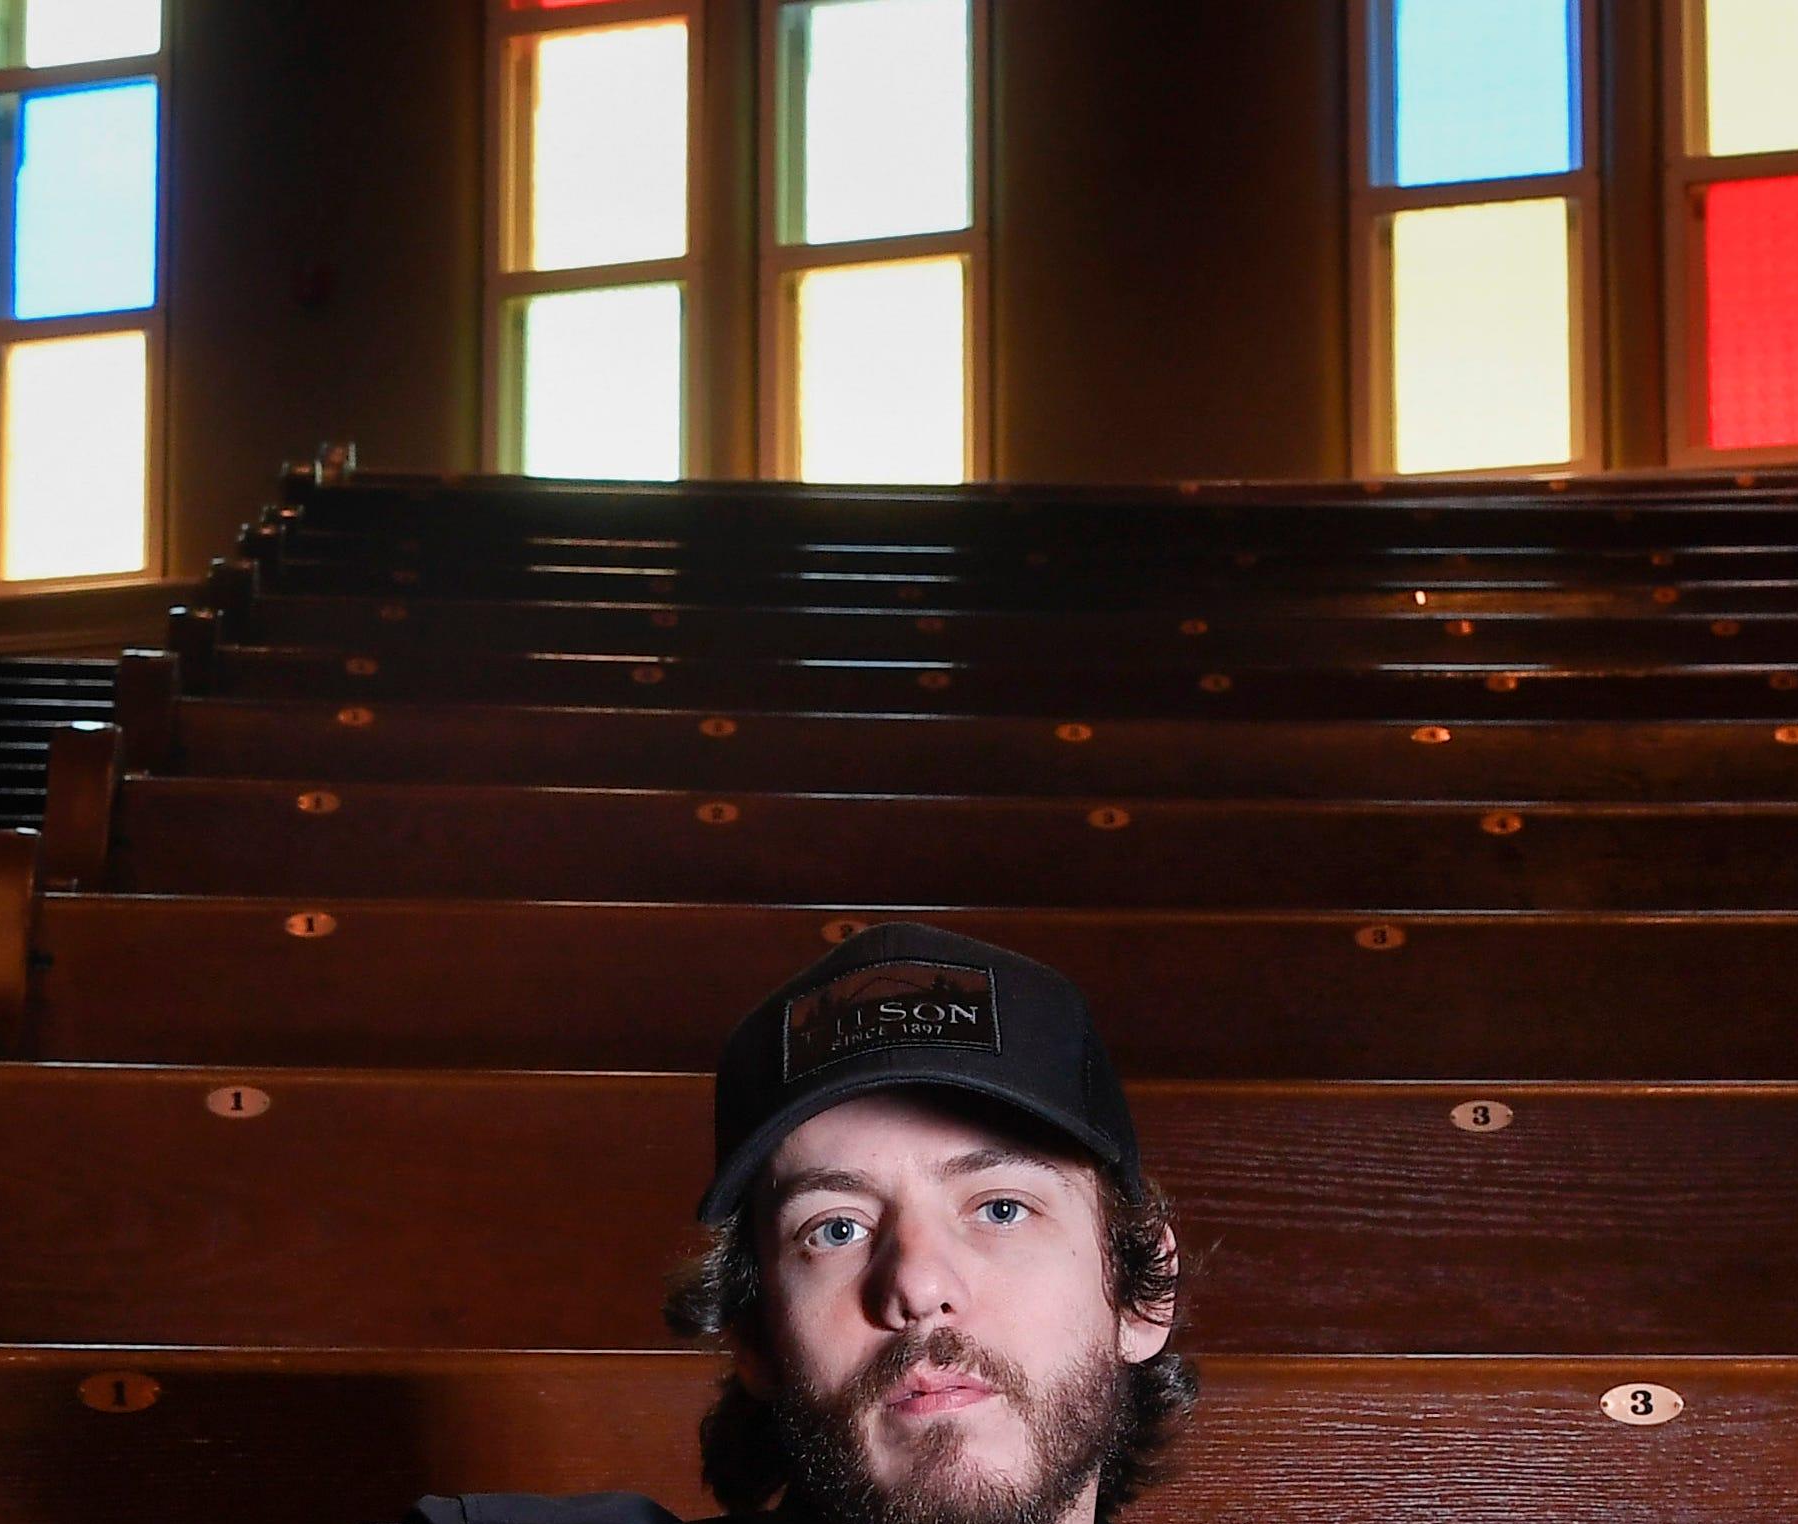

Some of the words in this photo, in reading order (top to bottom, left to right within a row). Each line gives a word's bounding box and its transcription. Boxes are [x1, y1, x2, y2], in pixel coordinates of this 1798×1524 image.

[305, 917, 317, 934] 1
[1372, 928, 1388, 945] 3
[901, 1022, 945, 1037] 1897
[229, 1089, 244, 1111] 1
[1472, 1105, 1491, 1127] 3
[110, 1380, 127, 1408] 1
[1630, 1389, 1654, 1416] 3
